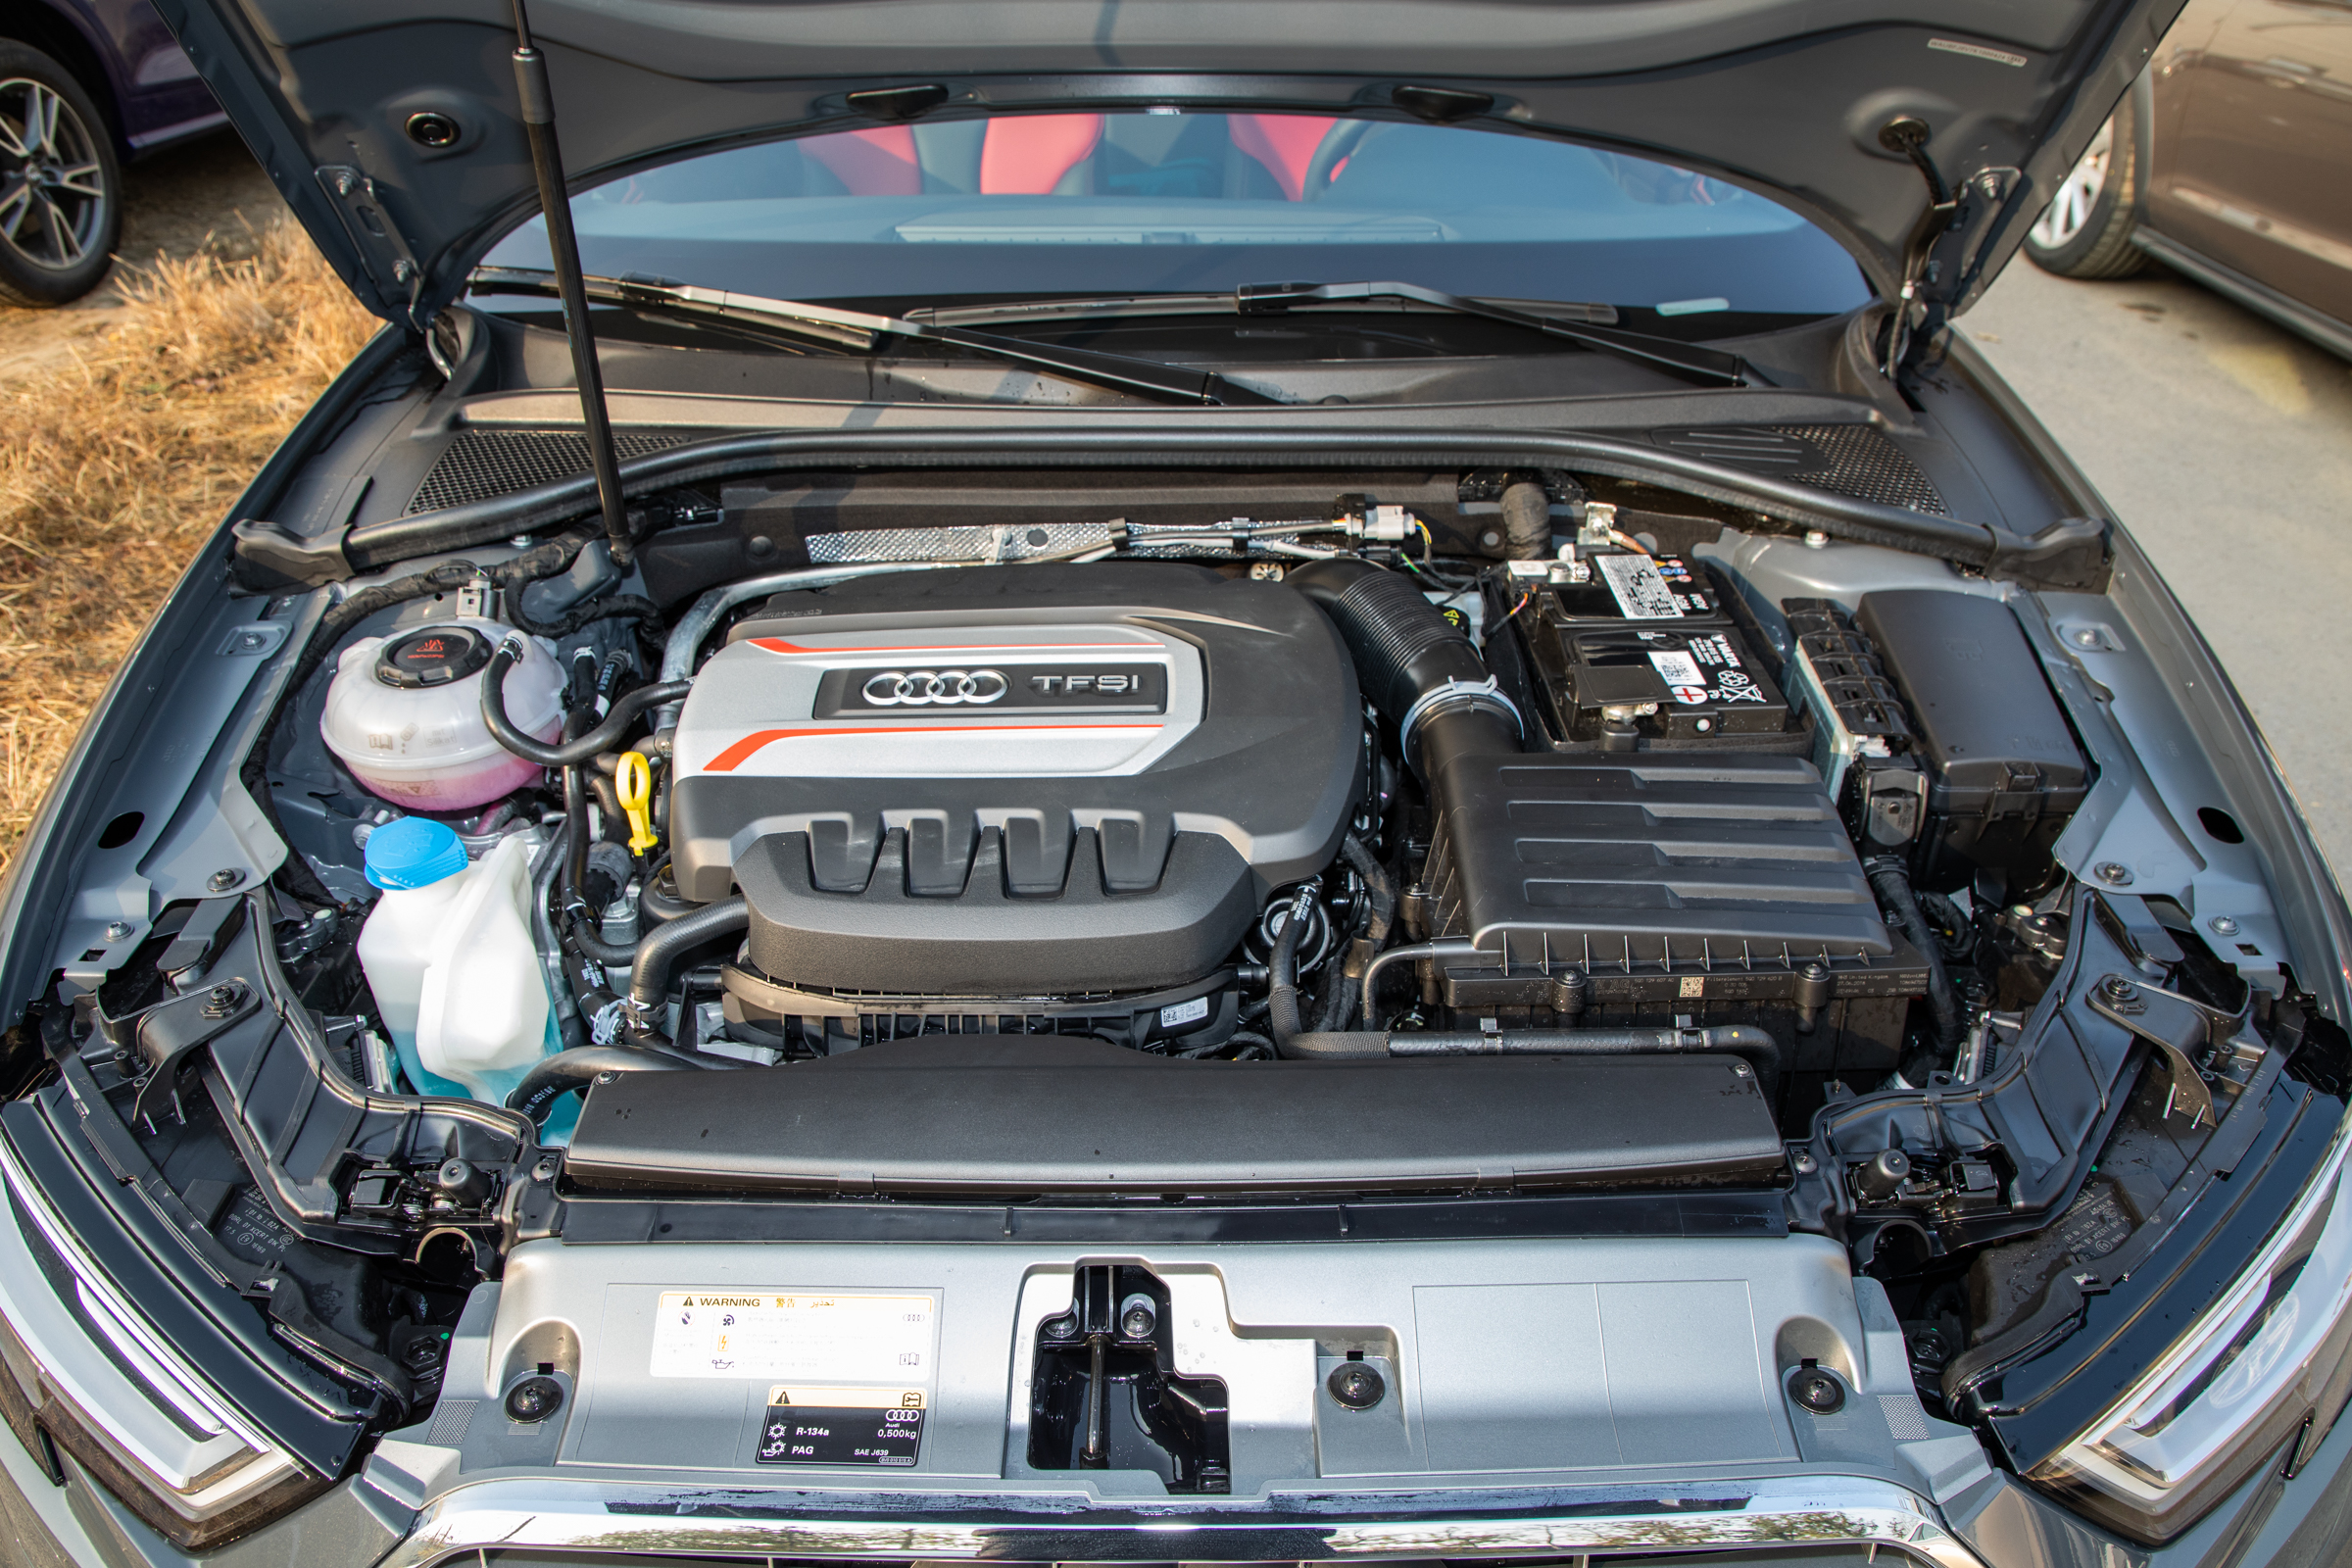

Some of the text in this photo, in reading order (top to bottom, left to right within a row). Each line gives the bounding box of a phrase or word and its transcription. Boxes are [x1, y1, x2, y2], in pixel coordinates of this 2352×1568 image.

[1717, 643, 1741, 667] VARTA
[1032, 674, 1139, 692] TFSI
[249, 1226, 270, 1240] XCERT
[700, 1298, 760, 1307] WARNING
[775, 1297, 796, 1308] 警告
[809, 1298, 835, 1308] تحذير
[796, 1427, 916, 1440] R-134a 0,500kg
[791, 1446, 814, 1455] PAG
[870, 1448, 889, 1457] J639
